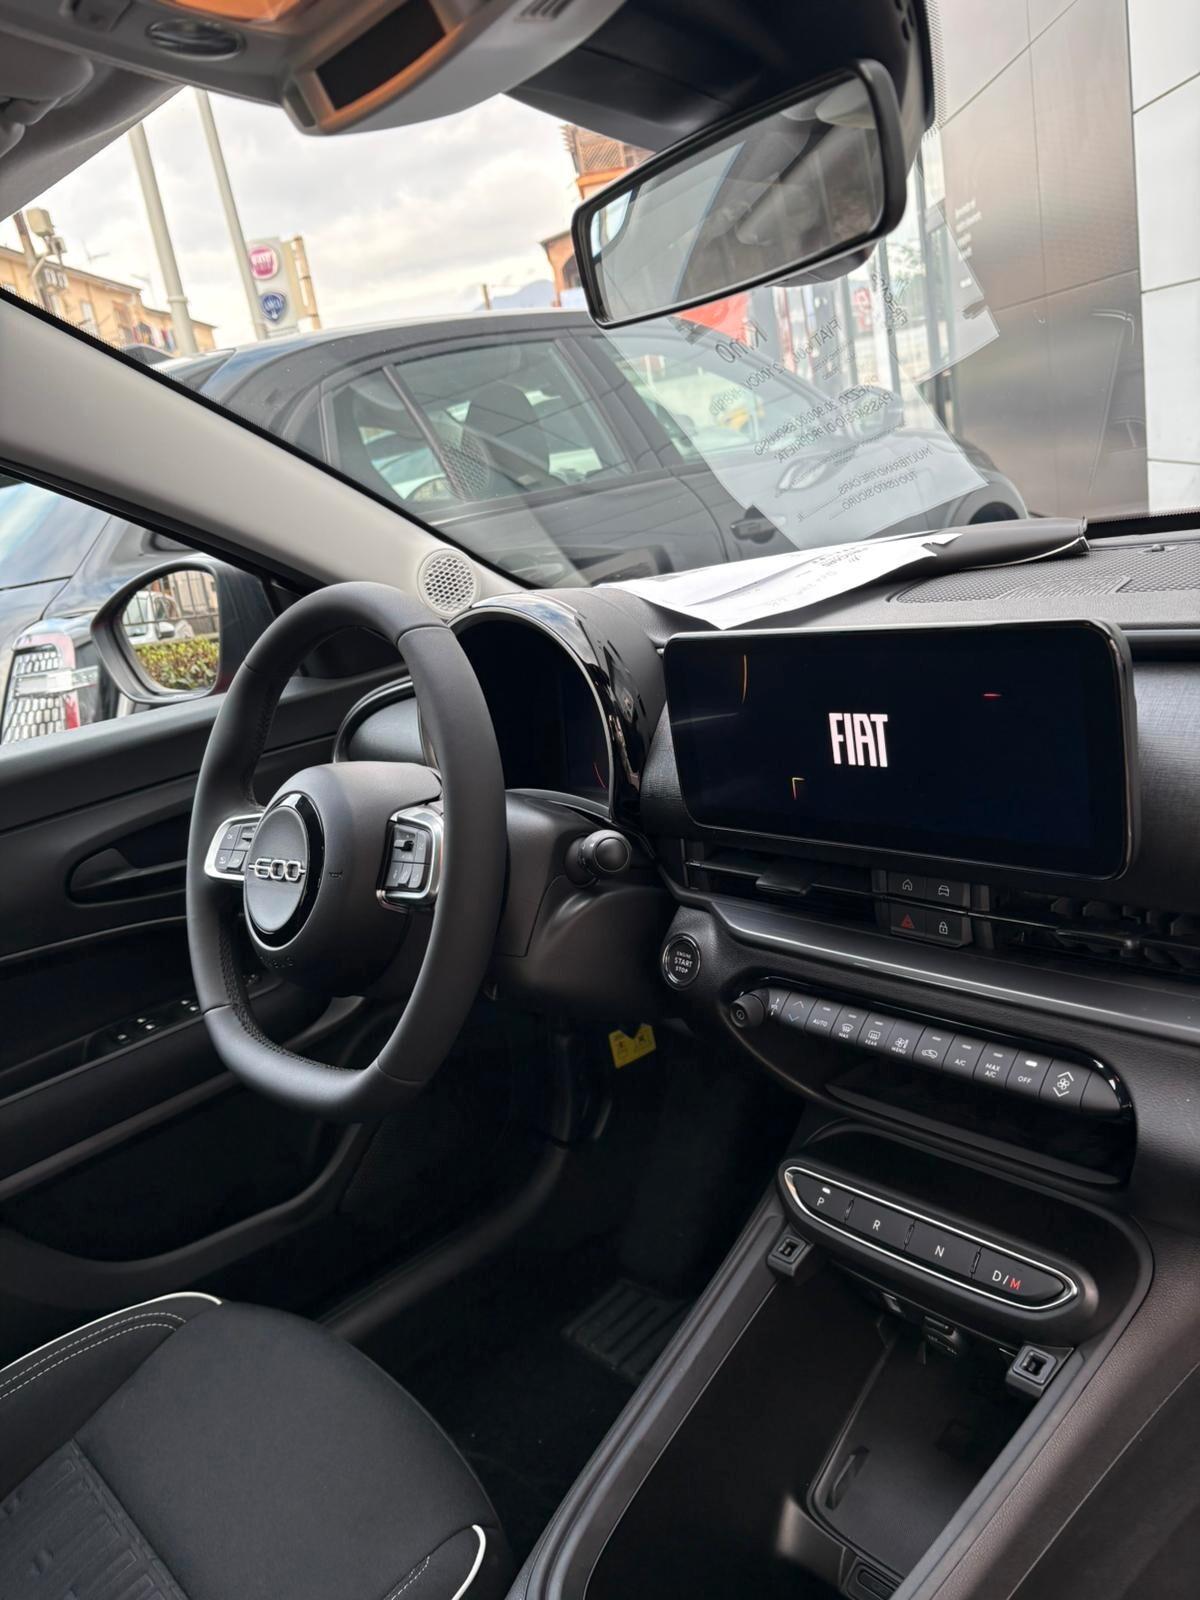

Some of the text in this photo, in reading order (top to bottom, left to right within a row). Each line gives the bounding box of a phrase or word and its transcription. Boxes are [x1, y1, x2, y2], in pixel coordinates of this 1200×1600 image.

[828, 712, 888, 768] FIAT
[254, 857, 301, 882] 600
[674, 956, 693, 968] START
[675, 965, 688, 974] STOP
[812, 1018, 829, 1028] AUTO
[954, 1058, 967, 1067] A/C
[985, 1062, 1001, 1072] MAX
[984, 1070, 997, 1079] A/C
[1017, 1075, 1032, 1085] OFF
[816, 1197, 825, 1206] P
[872, 1219, 881, 1231] R
[934, 1244, 945, 1259] N
[991, 1269, 1021, 1291] D/M
